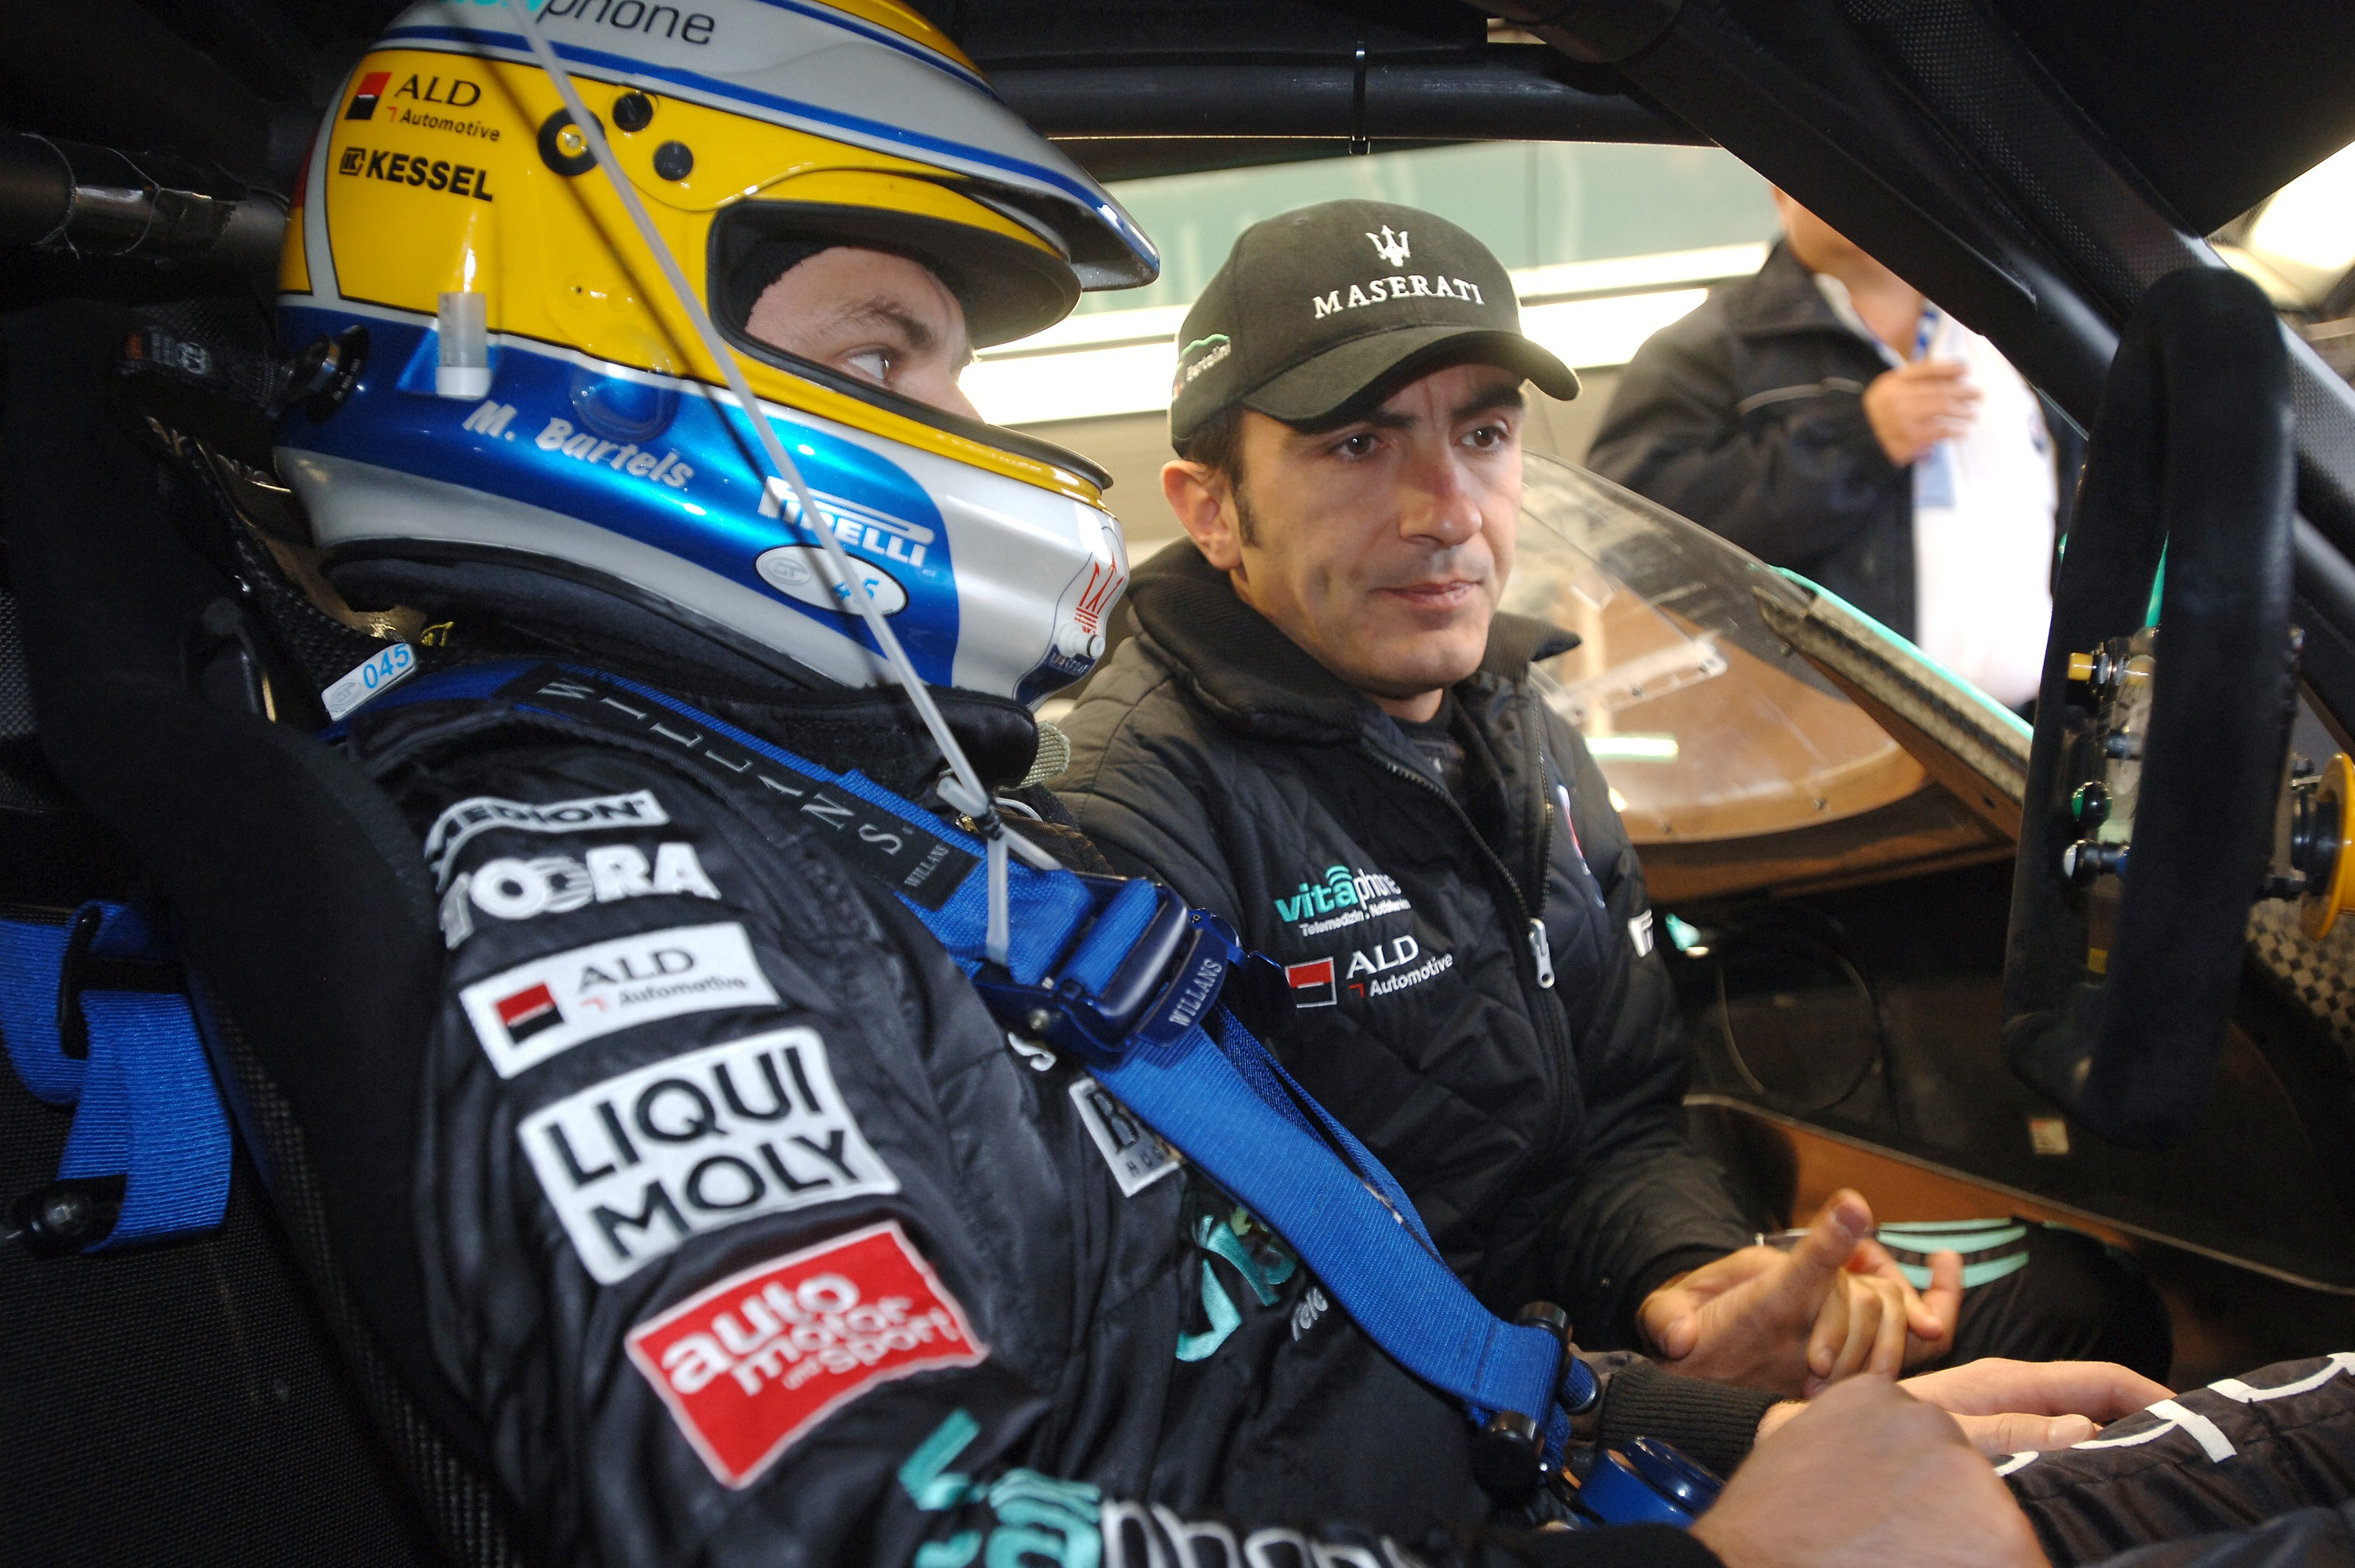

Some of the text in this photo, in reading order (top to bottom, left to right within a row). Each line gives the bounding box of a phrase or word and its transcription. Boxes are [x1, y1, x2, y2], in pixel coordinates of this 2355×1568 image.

[456, 0, 716, 45] phone
[393, 73, 481, 107] ALD
[400, 109, 500, 141] Automotive
[366, 149, 493, 203] KESSEL
[1313, 274, 1486, 319] MASERATI
[462, 400, 695, 488] M. Bartels
[758, 476, 934, 567] PIRELLI
[363, 642, 409, 689] 045
[903, 844, 948, 888] WILLANS
[1274, 867, 1402, 923] vitaphone
[578, 948, 695, 994] ALD
[1345, 935, 1419, 980] ALD
[1369, 953, 1454, 997] Automotive
[618, 976, 747, 1009] Automotive
[1168, 958, 1223, 1028] WILLANS
[543, 1045, 823, 1190] LIQUI
[589, 1129, 860, 1259] MOLY
[662, 1273, 860, 1396] auto
